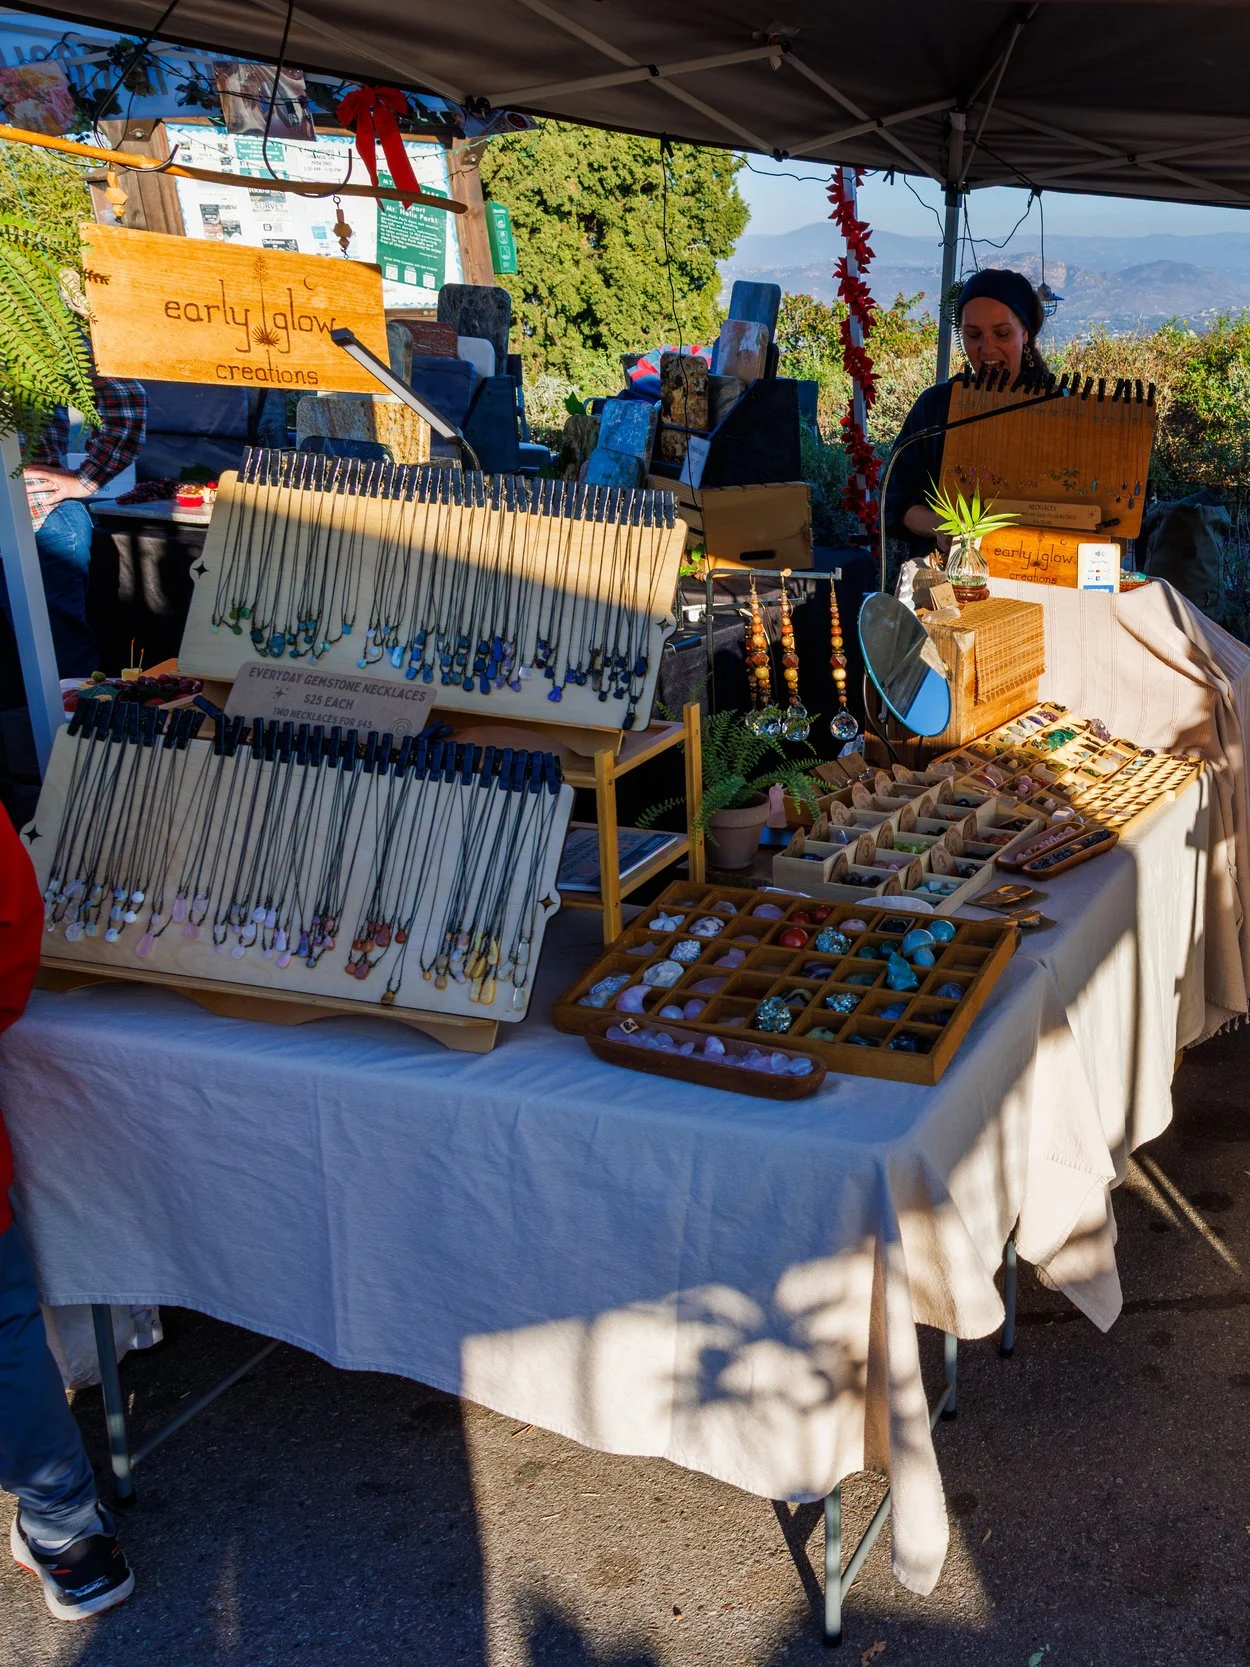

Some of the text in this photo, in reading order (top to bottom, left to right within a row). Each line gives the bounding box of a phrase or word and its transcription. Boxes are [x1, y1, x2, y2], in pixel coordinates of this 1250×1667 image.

[254, 202, 284, 210] SURVEY
[399, 208, 418, 219] Helix
[164, 279, 336, 353] early glow
[216, 358, 318, 385] creations
[1028, 503, 1057, 511] NECKLACES
[993, 540, 1074, 571] early glow
[1009, 571, 1058, 585] creations
[249, 667, 427, 702] EVERYDAY GEMSTONE NECKLACES
[304, 694, 355, 710] $25 EACH
[273, 707, 373, 729] TWO NECKLACES FOR $45
